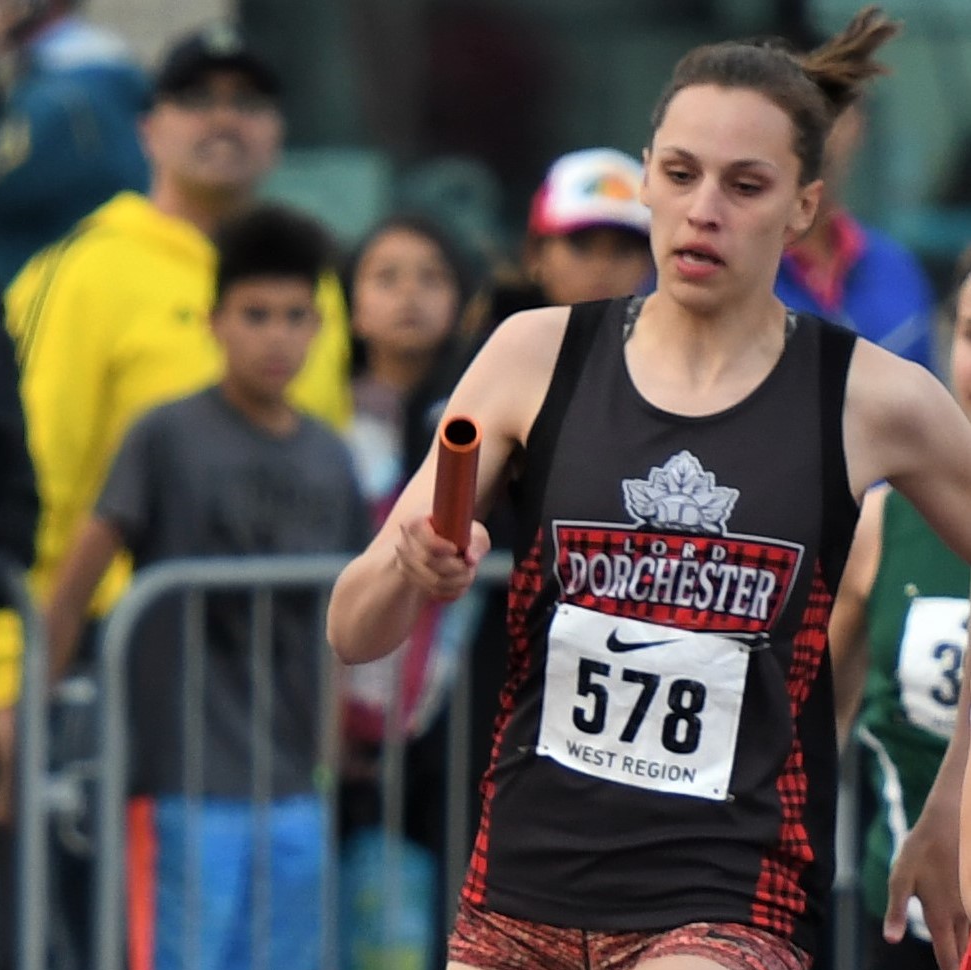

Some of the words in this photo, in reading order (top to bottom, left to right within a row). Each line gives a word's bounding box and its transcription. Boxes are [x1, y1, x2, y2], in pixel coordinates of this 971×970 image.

[623, 537, 727, 561] LORD
[566, 552, 776, 620] DORCHESTER
[572, 656, 707, 754] 578
[566, 739, 618, 768] WEST
[622, 756, 697, 783] REGION
